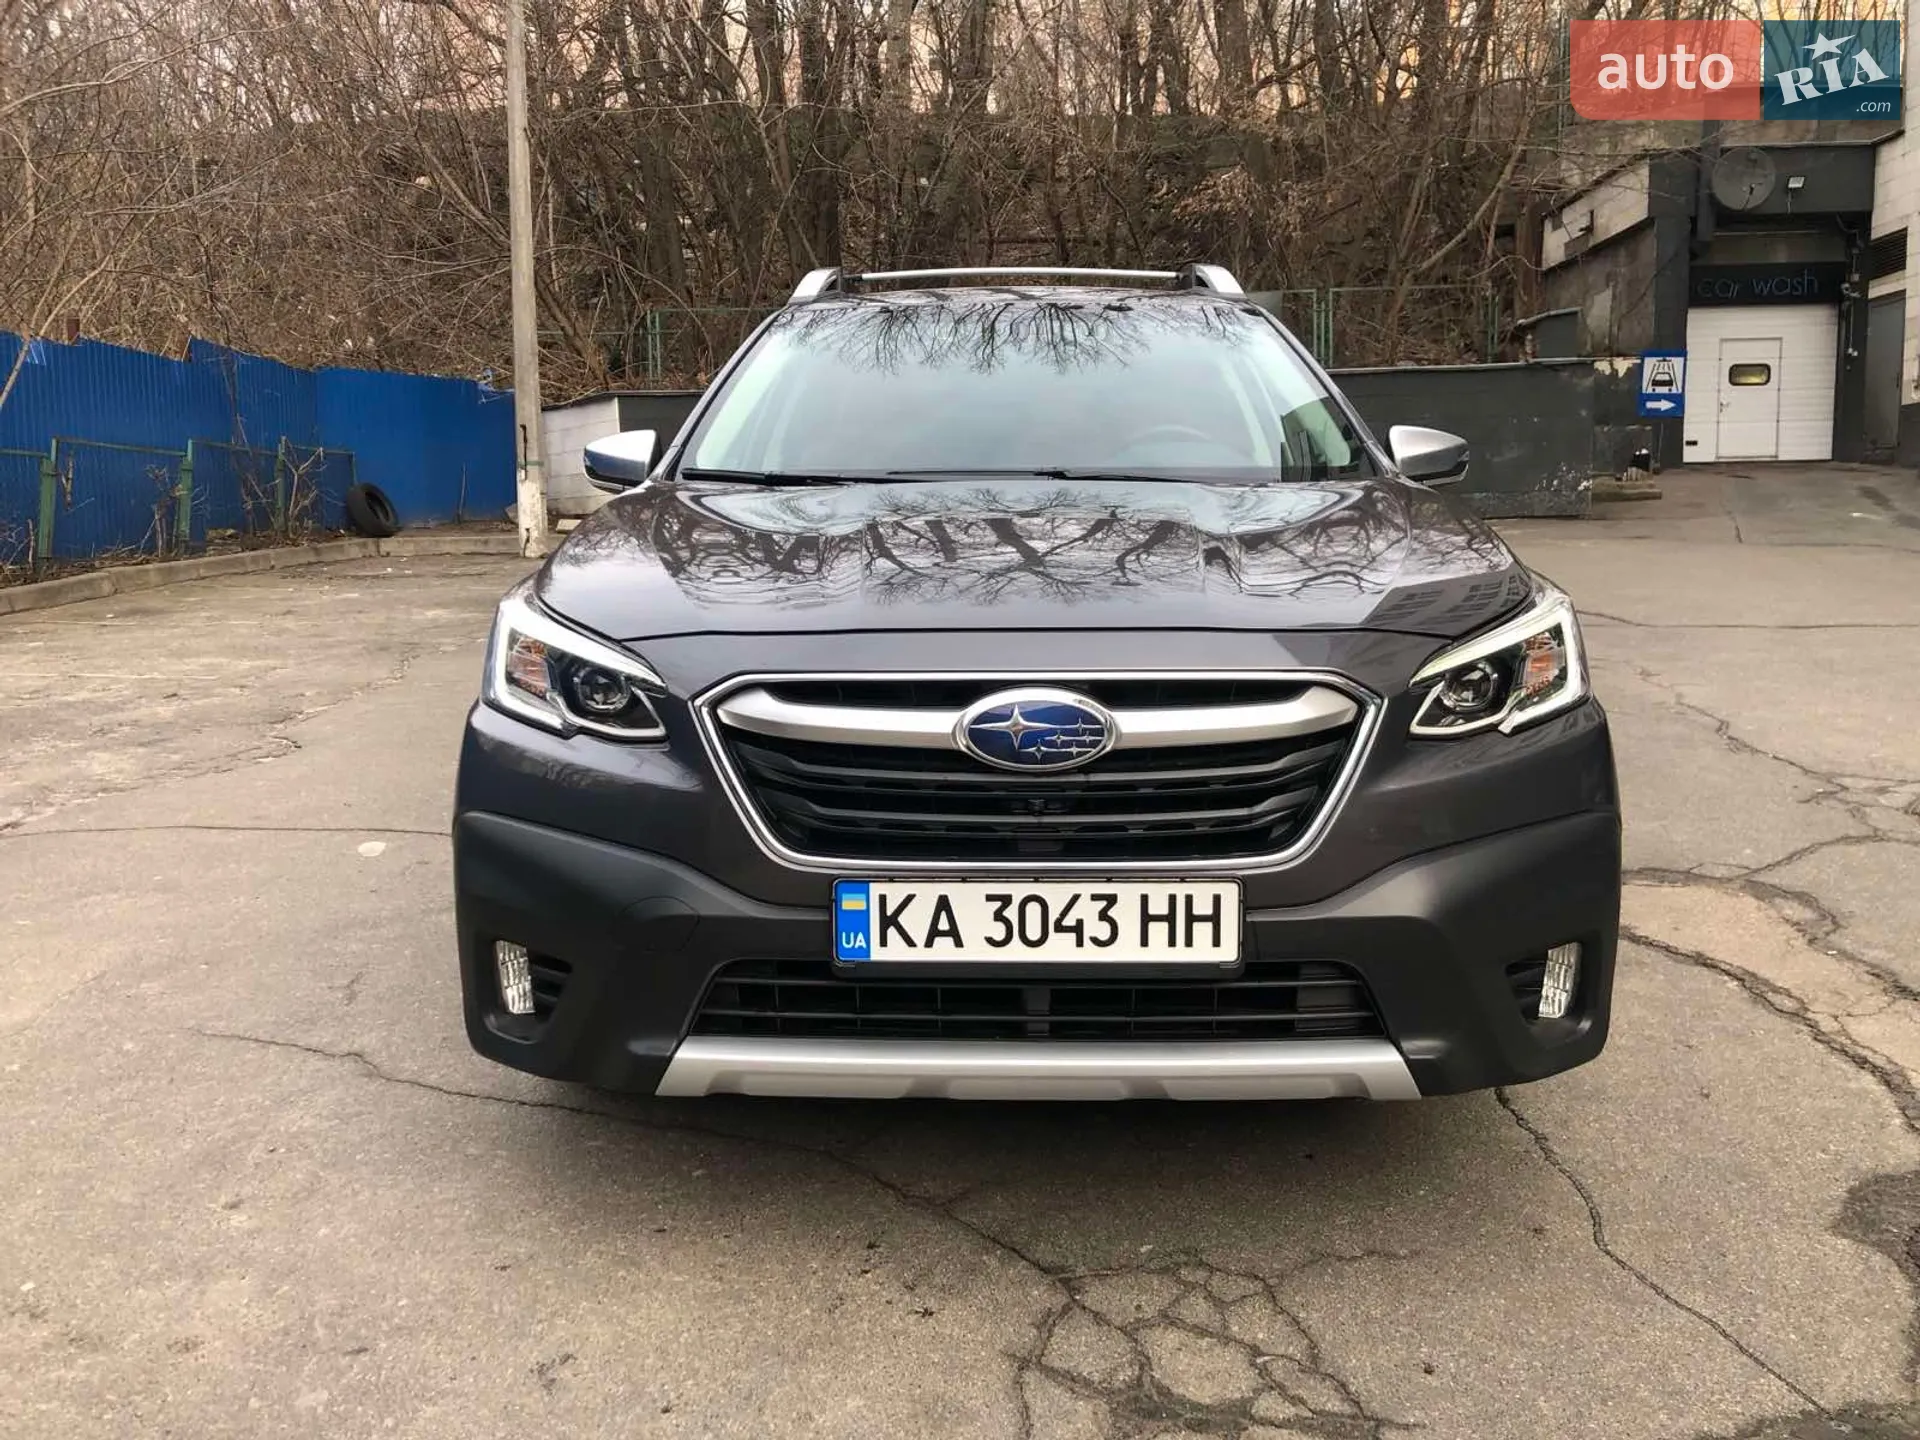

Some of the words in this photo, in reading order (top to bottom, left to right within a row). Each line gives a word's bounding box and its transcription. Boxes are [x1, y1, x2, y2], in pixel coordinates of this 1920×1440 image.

[1698, 278, 1742, 299] car
[1751, 269, 1818, 297] wash
[878, 893, 964, 949] KA
[984, 893, 1119, 949] 3043
[1140, 893, 1222, 949] HH
[841, 931, 867, 949] UA
